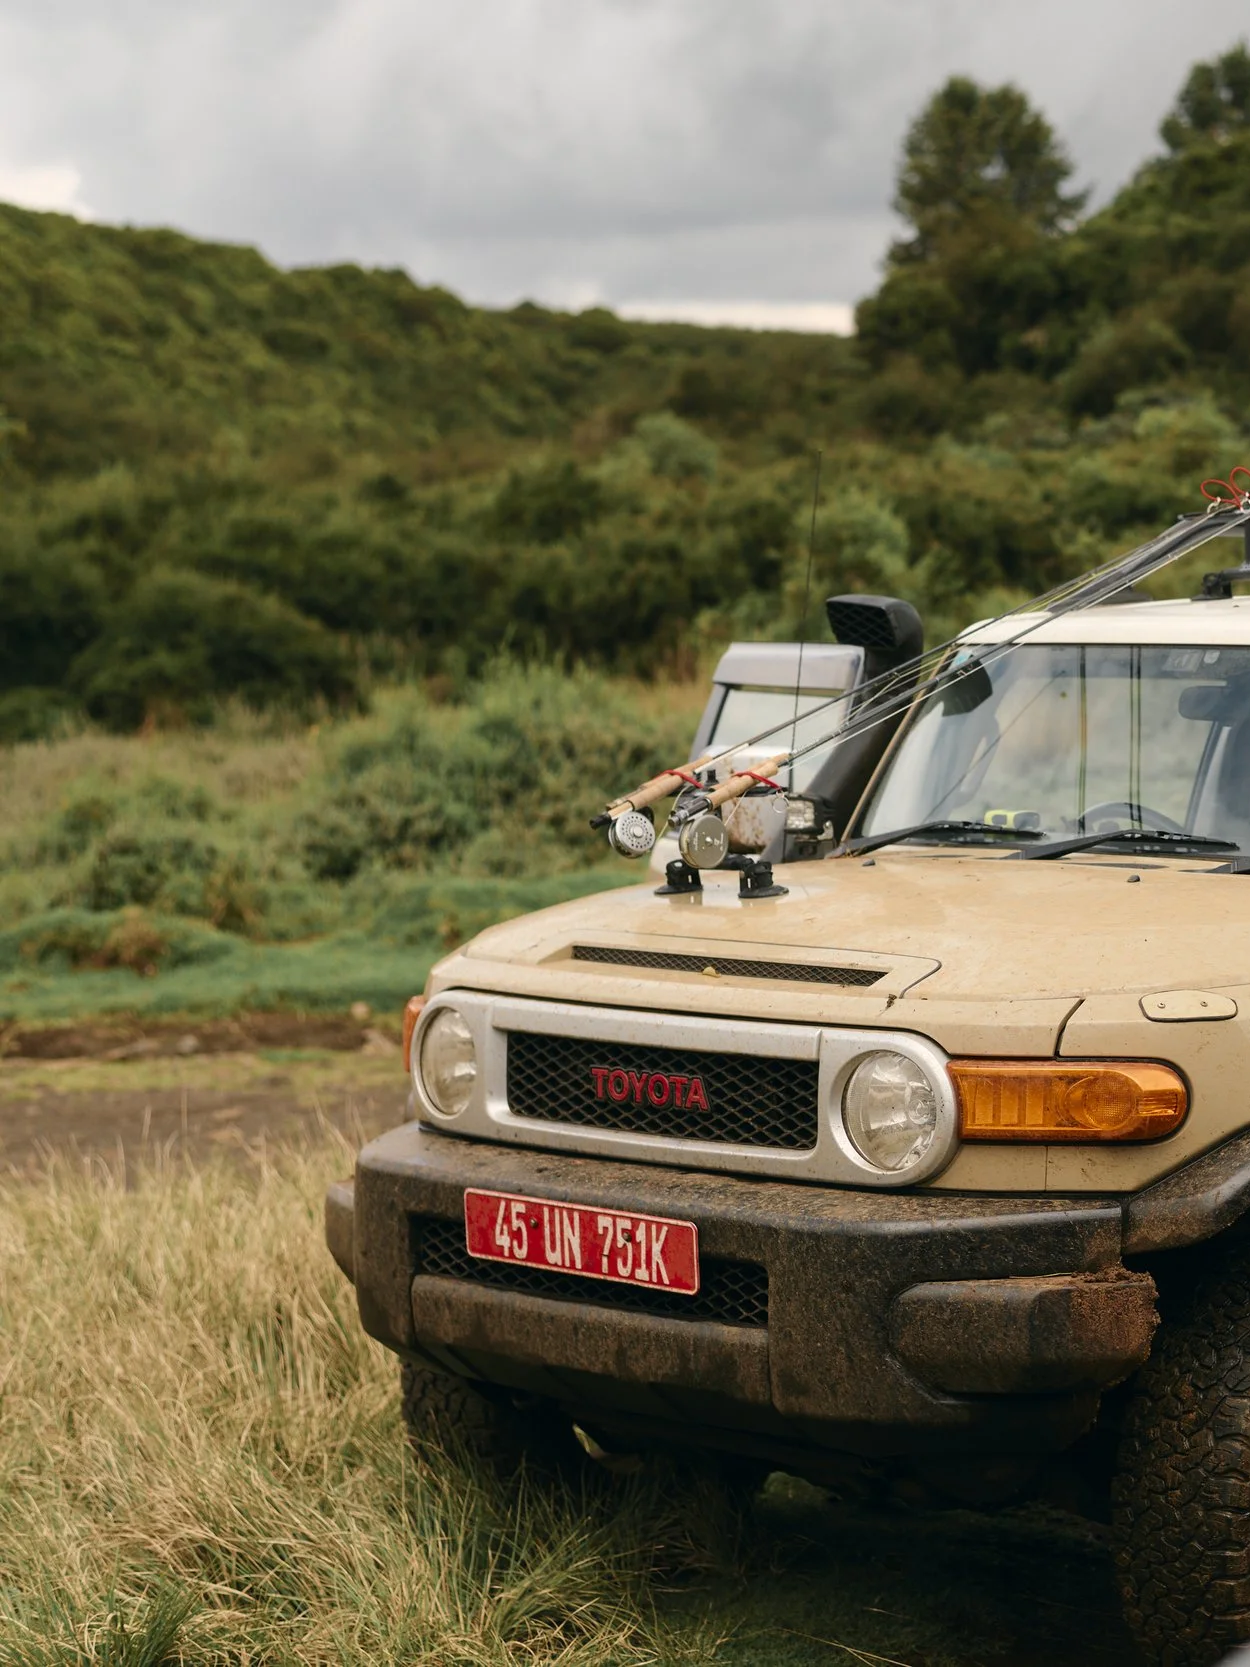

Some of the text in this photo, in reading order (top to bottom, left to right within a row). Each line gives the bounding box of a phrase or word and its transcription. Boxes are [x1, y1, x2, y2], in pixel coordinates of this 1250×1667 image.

[591, 1067, 709, 1111] TOYOTA
[495, 1200, 670, 1285] 45 UN 751K
